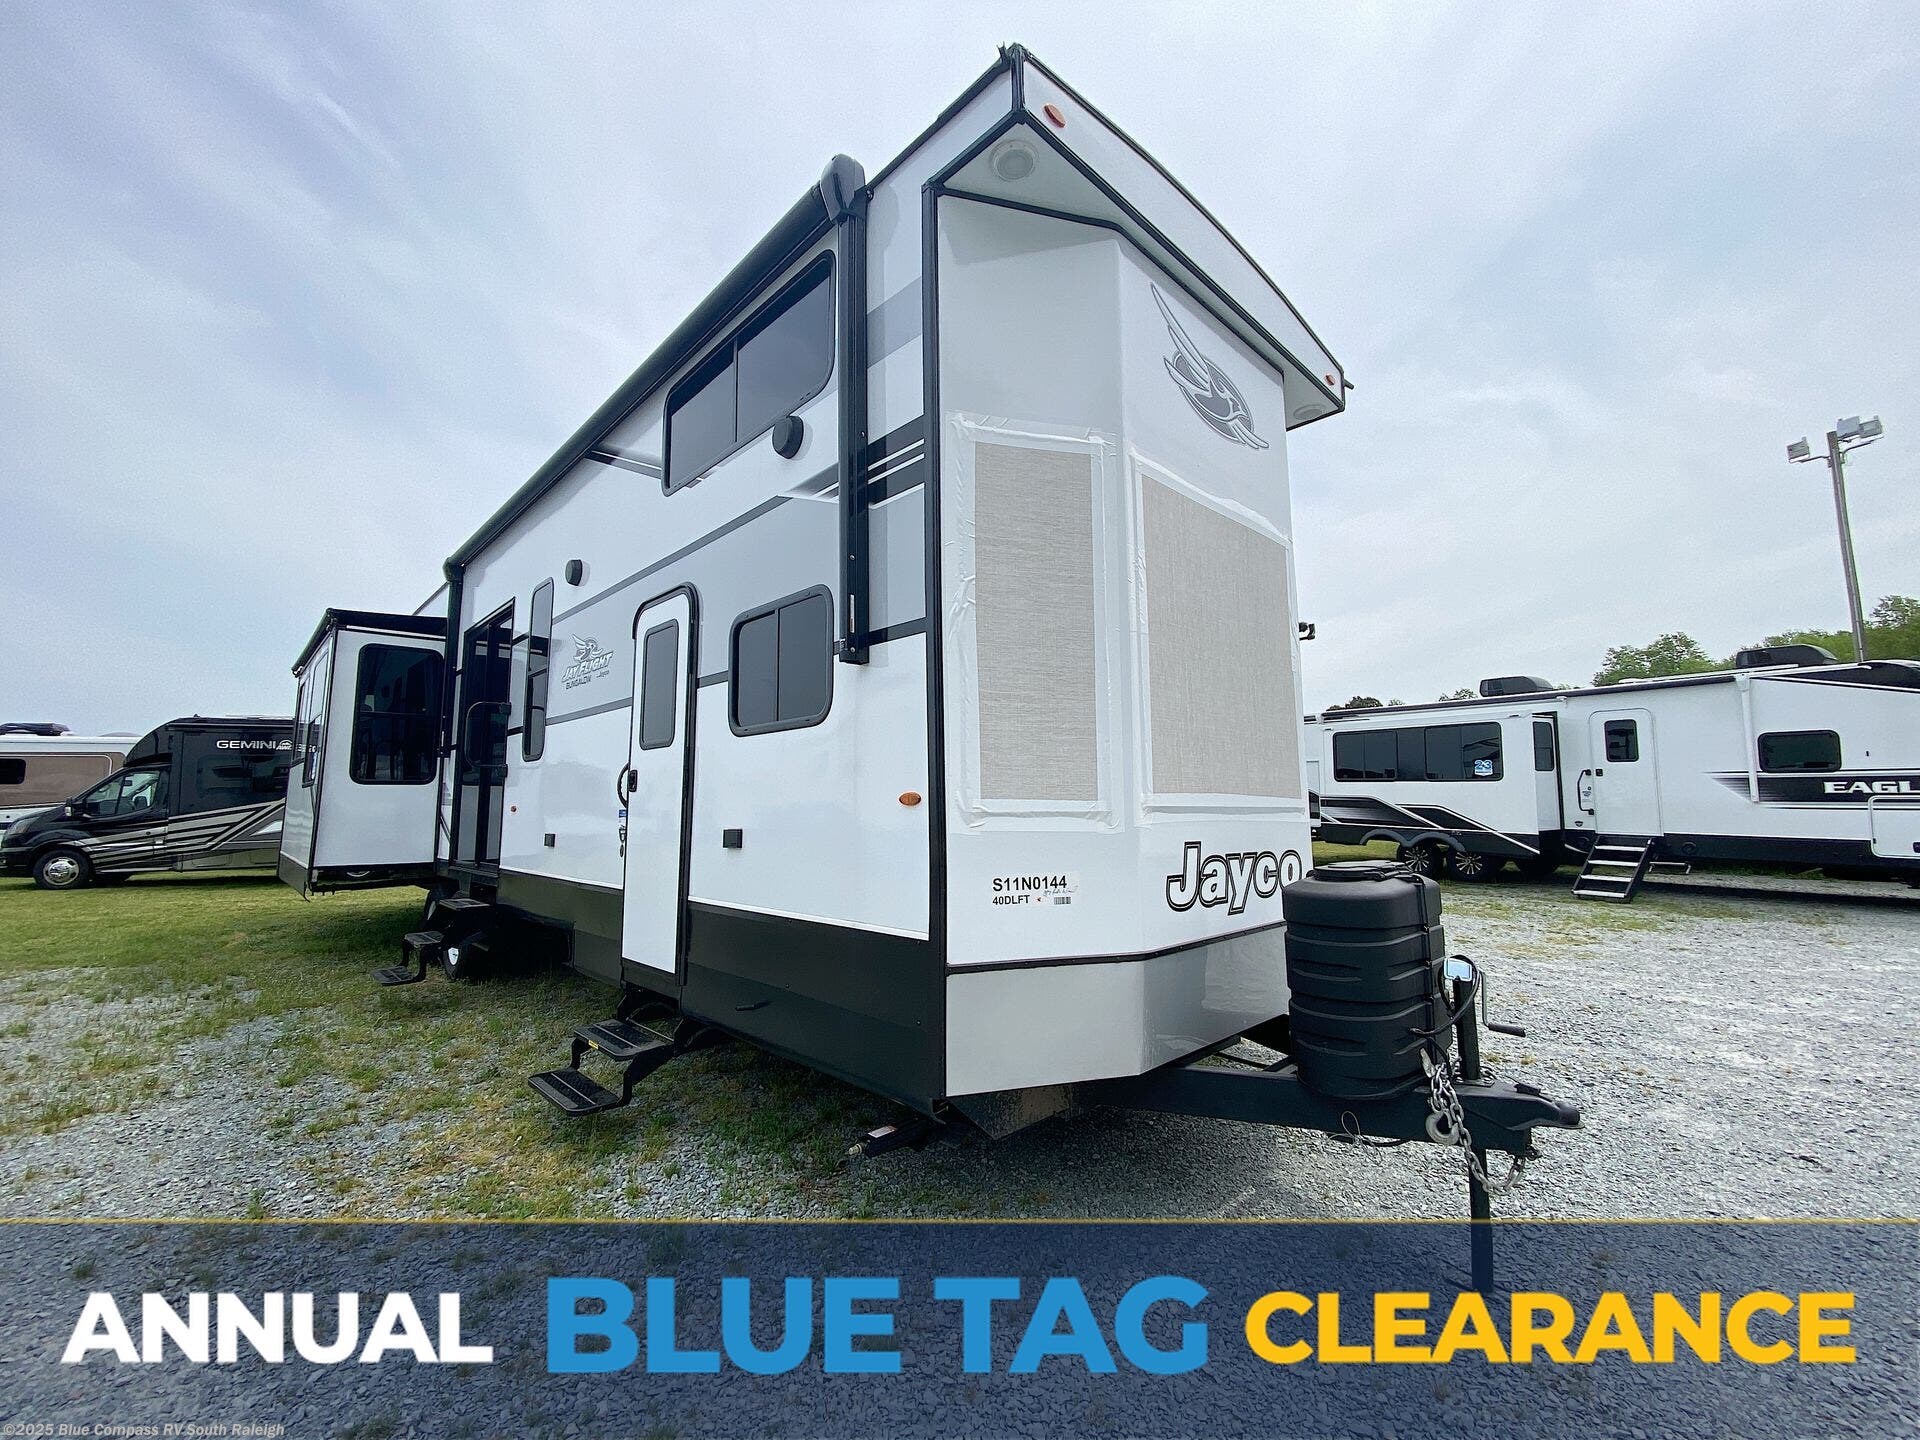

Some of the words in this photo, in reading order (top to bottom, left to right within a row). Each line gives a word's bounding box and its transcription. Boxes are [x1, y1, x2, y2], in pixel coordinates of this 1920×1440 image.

[216, 740, 276, 749] GEMINI
[992, 875, 1067, 892] S11N0144
[1165, 840, 1302, 916] Jayco
[992, 894, 1030, 905] 40DLFT
